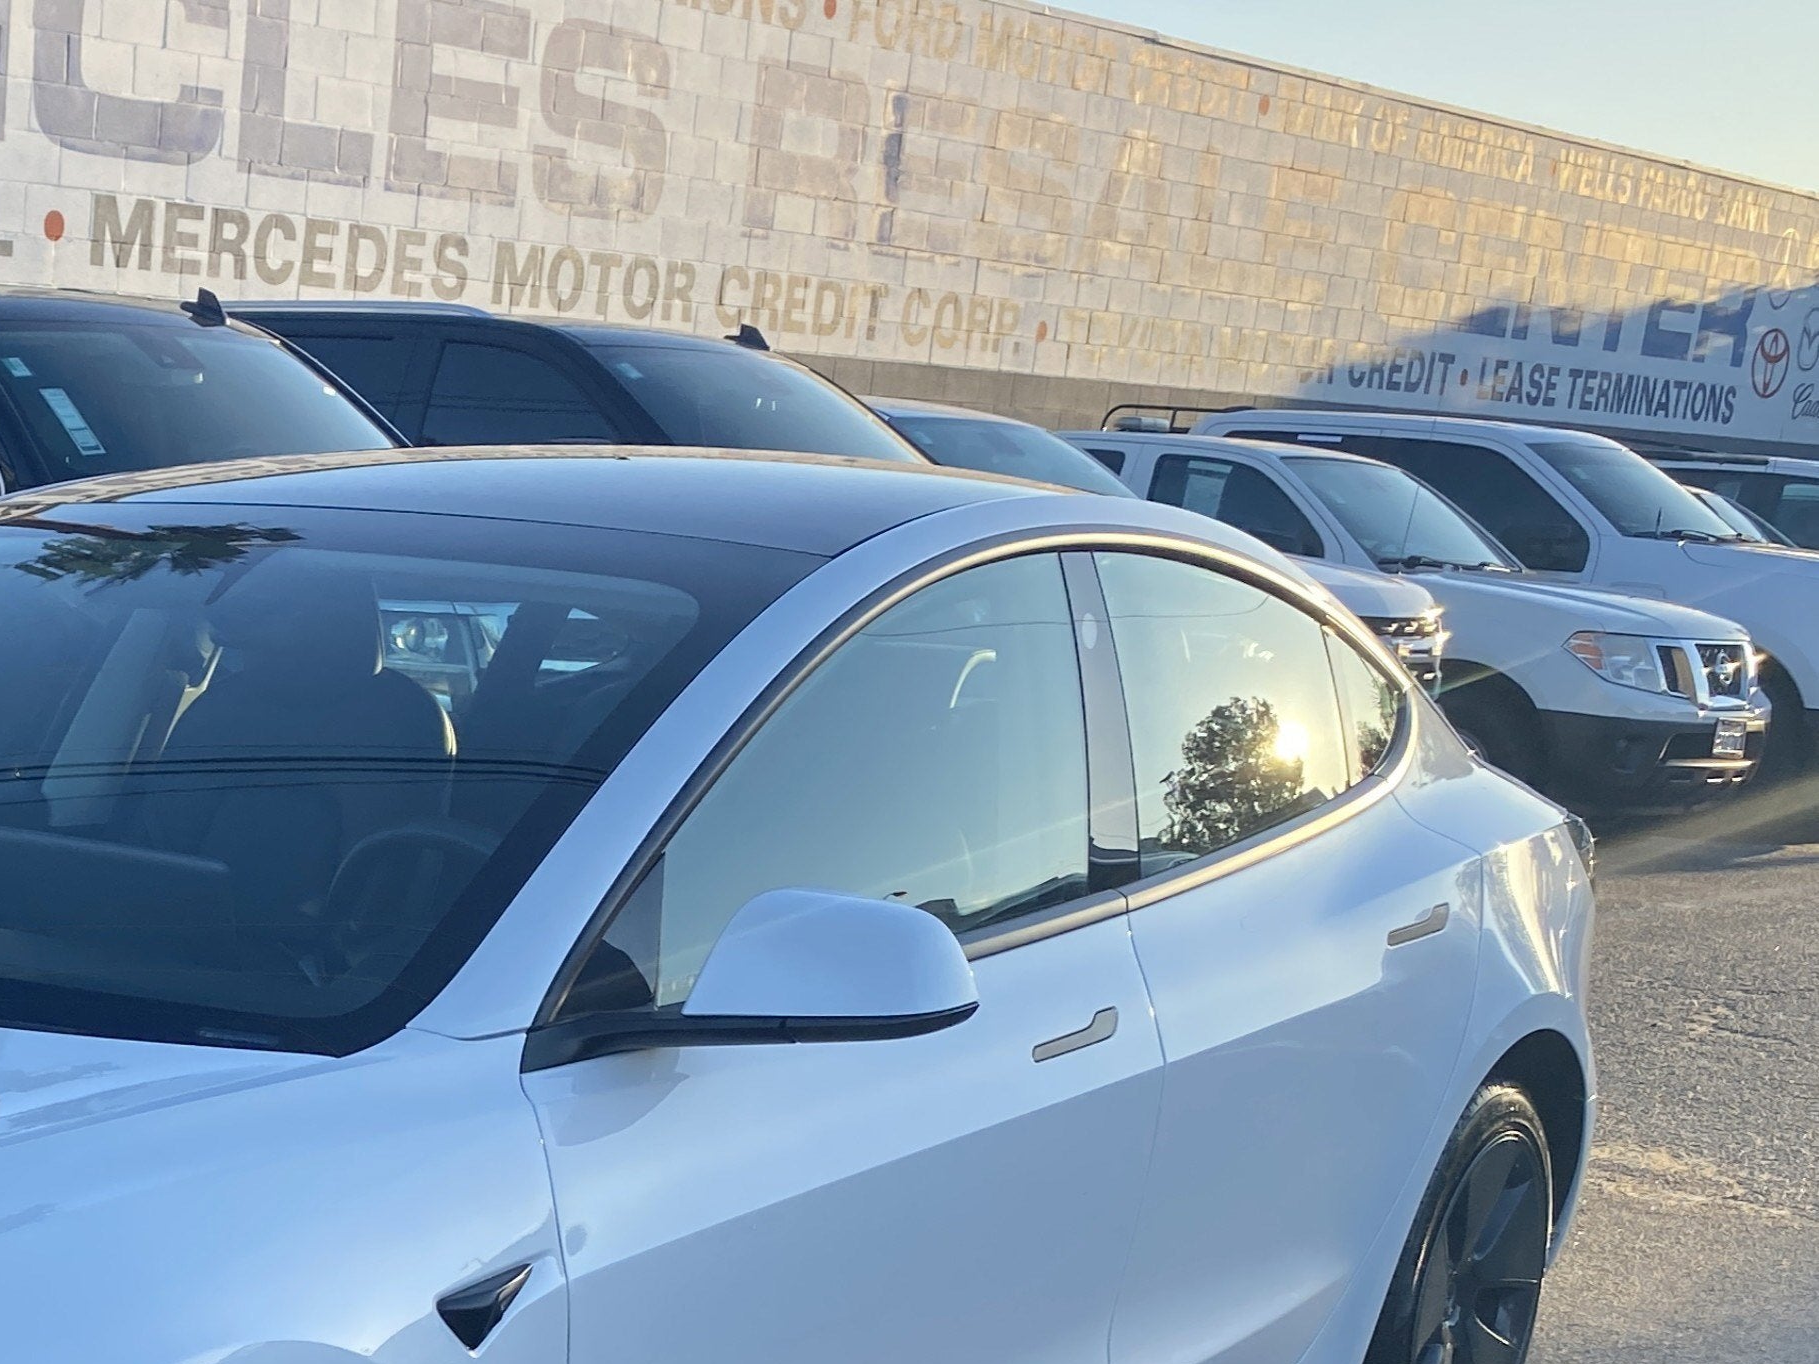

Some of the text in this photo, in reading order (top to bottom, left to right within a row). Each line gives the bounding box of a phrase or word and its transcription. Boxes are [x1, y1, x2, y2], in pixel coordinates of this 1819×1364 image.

[89, 194, 469, 303] MERCEDES
[492, 241, 696, 324] MOTOR
[714, 265, 889, 341] CREDIT
[1346, 343, 1456, 397] CREDIT
[1475, 356, 1561, 407] LEASE
[1568, 367, 1737, 425] TERMINATIONS
